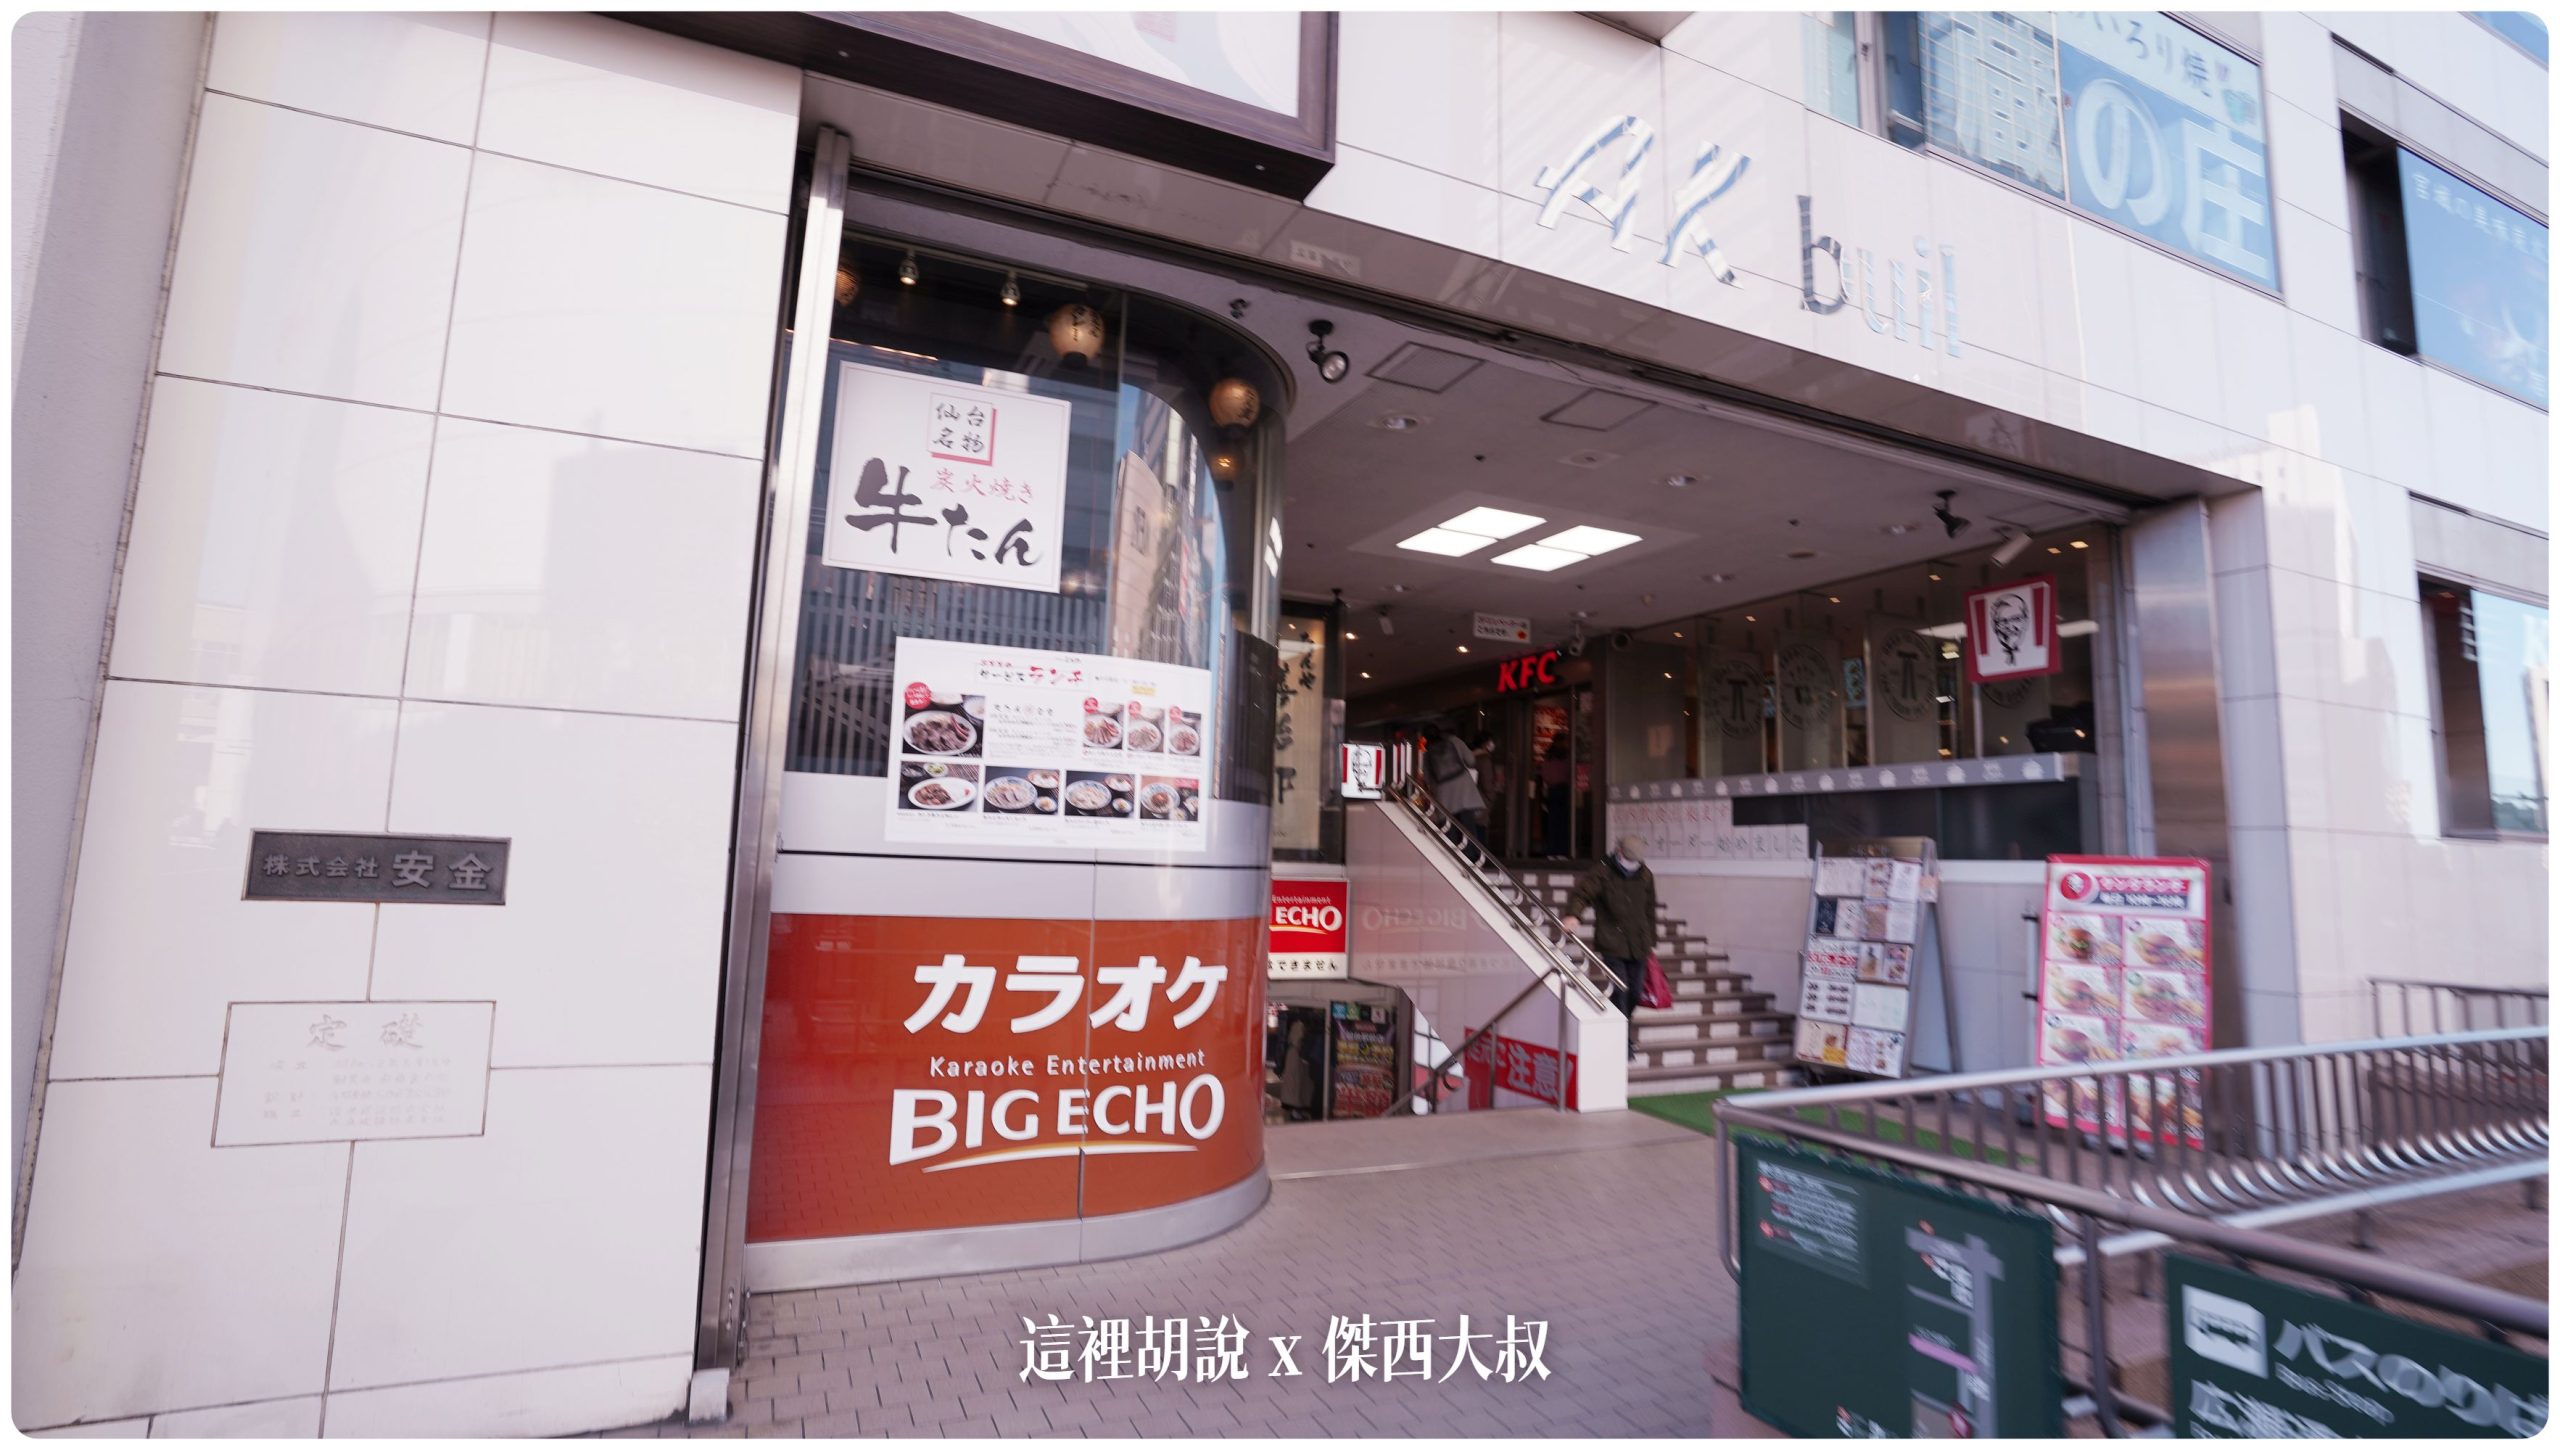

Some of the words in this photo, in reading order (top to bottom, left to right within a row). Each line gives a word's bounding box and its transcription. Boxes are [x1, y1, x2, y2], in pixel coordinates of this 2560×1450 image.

[1796, 193, 1961, 359] buil
[936, 402, 986, 427] 仙台
[932, 426, 985, 454] 名物
[929, 466, 1034, 505] 炭火焼き
[844, 456, 1044, 567] 牛たん
[1496, 649, 1558, 694] KFC
[263, 853, 379, 879] 株式会社
[391, 849, 494, 891] 安金
[1275, 905, 1343, 932] ECHO
[903, 953, 1230, 1035] カラオケ
[929, 1054, 1035, 1078] Karaoke
[1046, 1048, 1206, 1077] Entertainment
[889, 1088, 1040, 1167] BIG
[1056, 1073, 1226, 1141] ECHO
